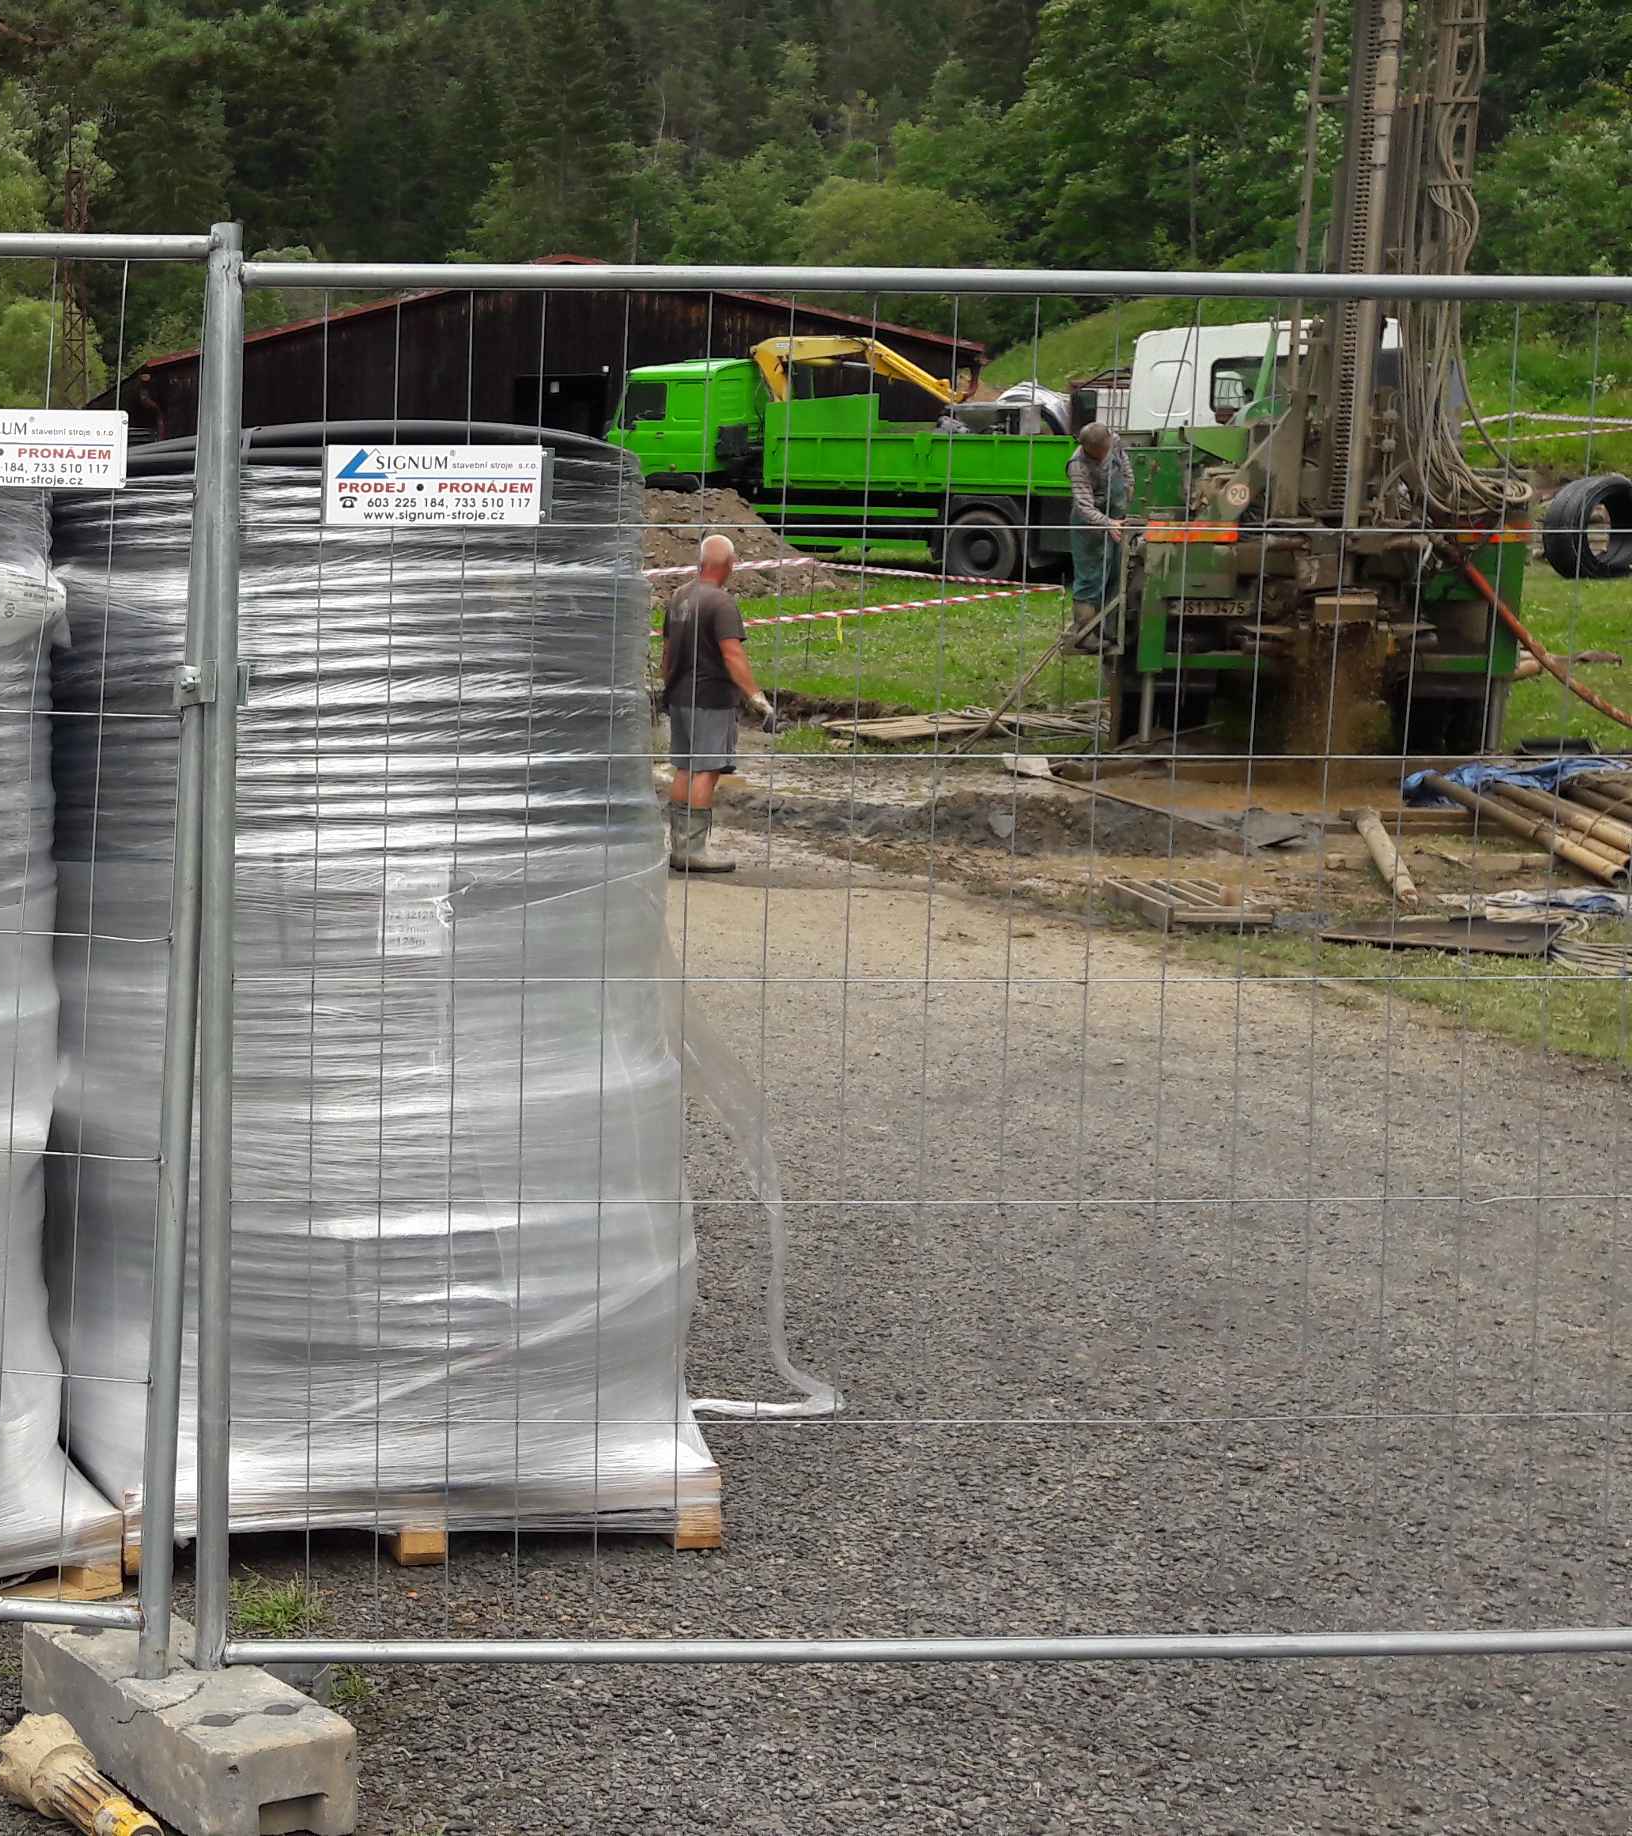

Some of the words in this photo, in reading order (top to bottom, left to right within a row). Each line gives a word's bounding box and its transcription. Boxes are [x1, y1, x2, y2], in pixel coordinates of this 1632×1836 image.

[68, 428, 91, 437] stroje
[17, 445, 112, 460] PRONÁJEM
[4, 462, 29, 474] 184,
[33, 463, 55, 473] 733
[60, 463, 82, 474] 510
[88, 464, 109, 474] 117
[375, 455, 449, 471] SIGNUM
[452, 461, 488, 470] stavební
[490, 461, 514, 471] stroje
[518, 462, 538, 470] s.r.o.
[338, 482, 407, 493] PRODEJ
[438, 479, 534, 494] PRONÁJEM
[1231, 487, 1247, 500] 90
[367, 498, 390, 508] 603
[394, 498, 417, 508] 225
[424, 498, 449, 509] 184,
[454, 498, 476, 508] 733
[482, 498, 504, 508] 510
[510, 498, 530, 508] 117
[363, 510, 506, 522] www.signum-stroje.cz
